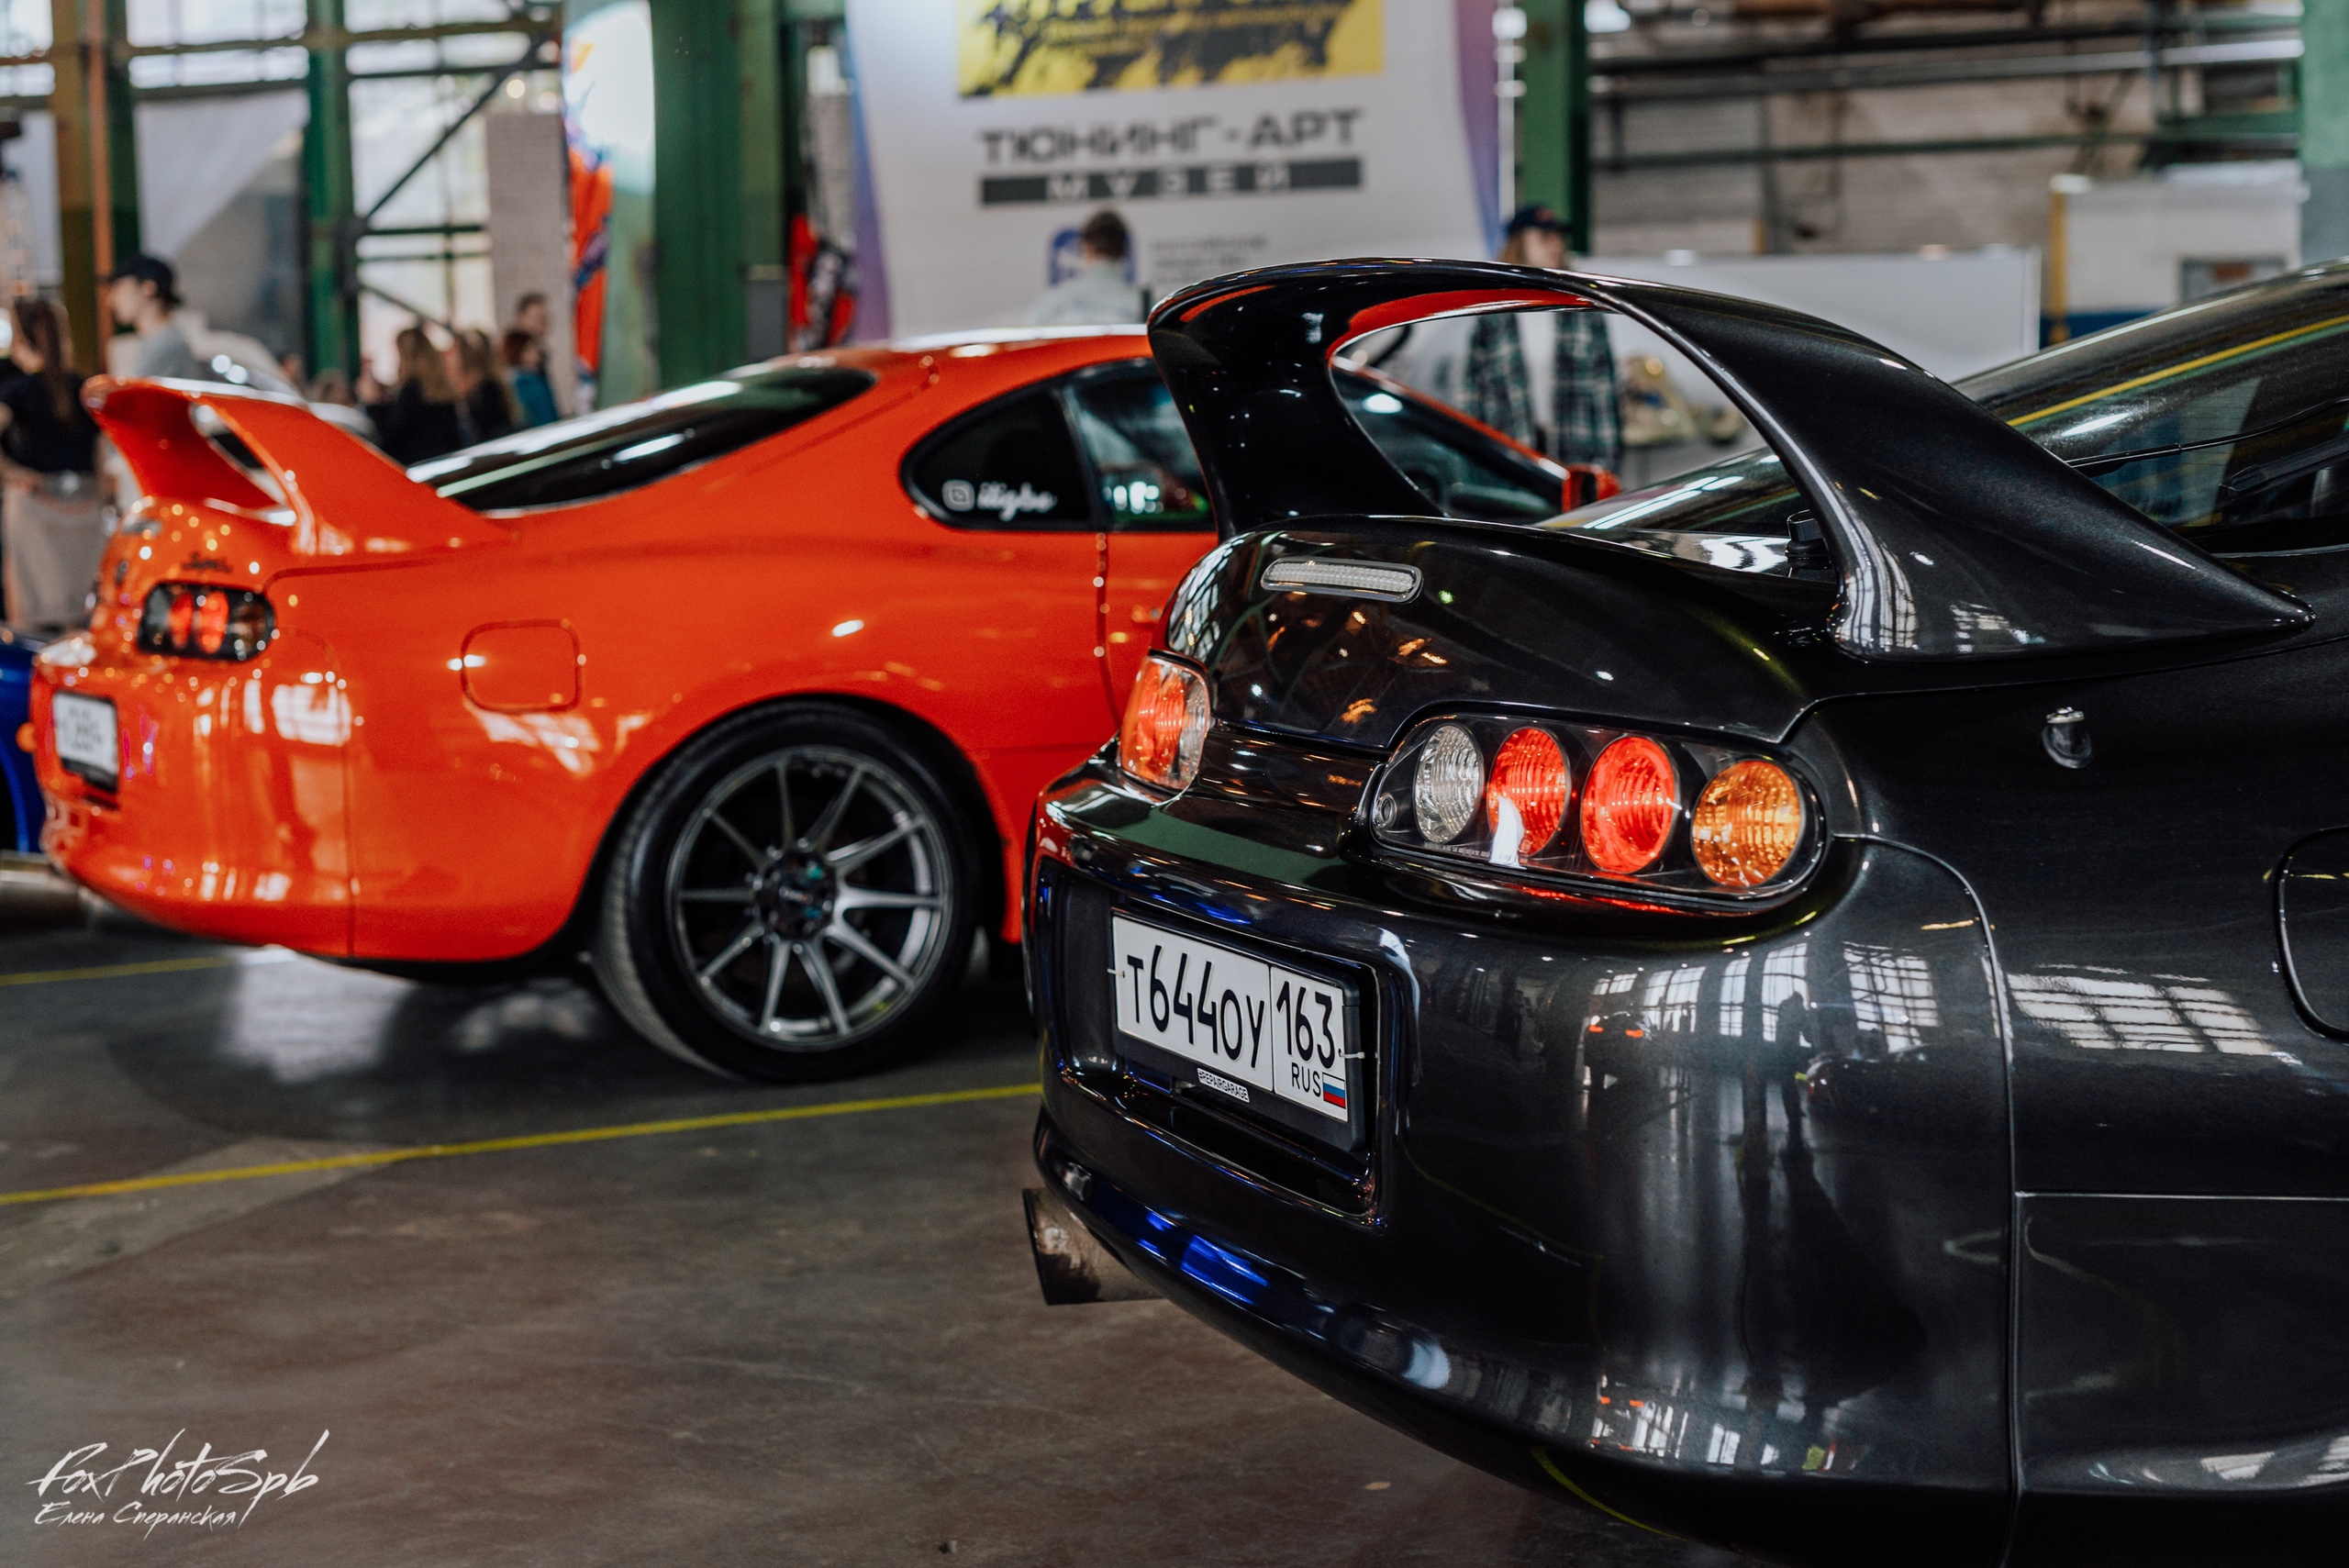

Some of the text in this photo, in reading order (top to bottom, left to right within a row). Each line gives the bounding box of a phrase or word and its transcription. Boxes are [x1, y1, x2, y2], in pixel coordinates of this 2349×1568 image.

[981, 108, 1359, 163] ТЮНИНГ-АРТ
[1047, 163, 1290, 203] МУЗЕЙ
[1127, 944, 1335, 1069] Т644ОУ 163
[1291, 1062, 1321, 1097] RUS
